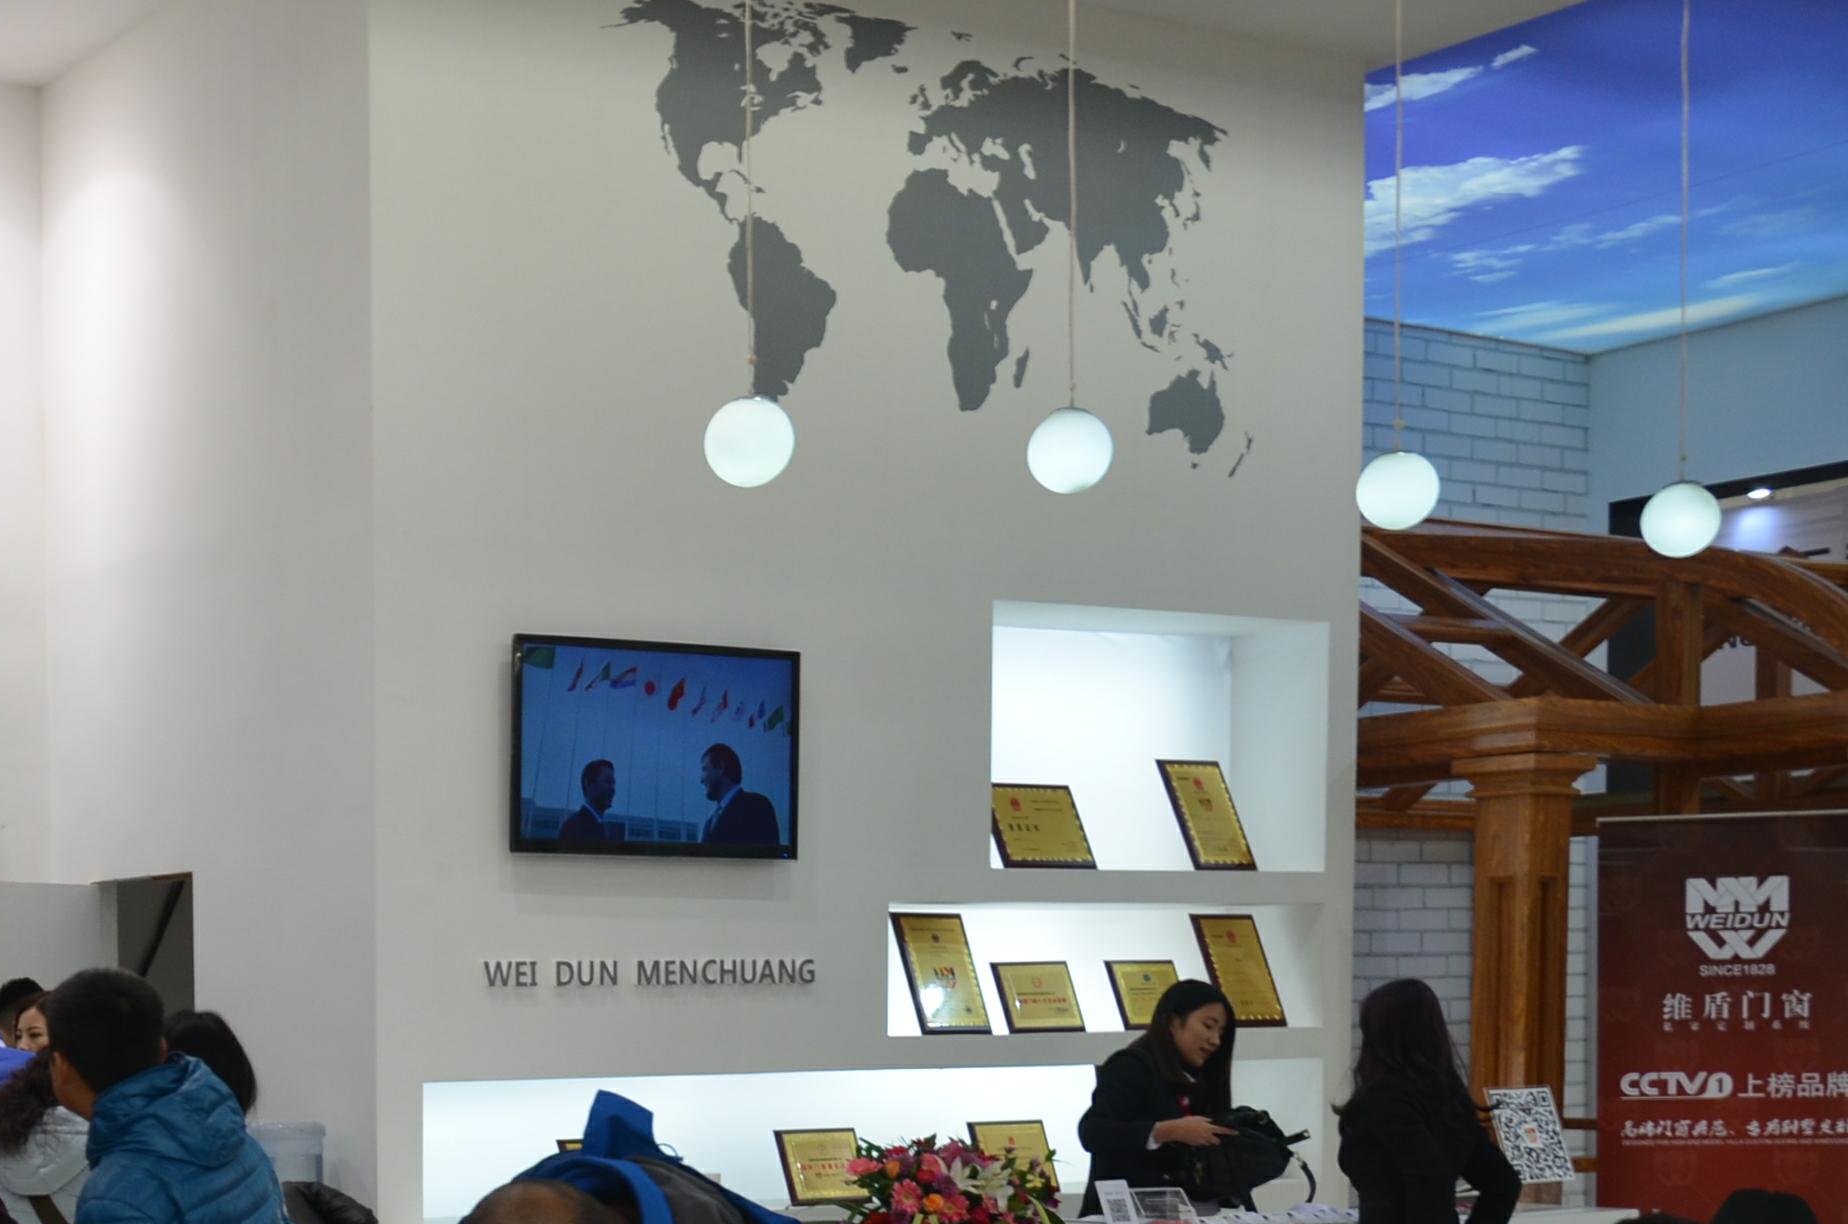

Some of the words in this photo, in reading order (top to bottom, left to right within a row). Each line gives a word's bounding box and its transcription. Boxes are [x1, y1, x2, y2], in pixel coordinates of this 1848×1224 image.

[1686, 912, 1790, 930] WEIDUN
[483, 960, 538, 987] WEI
[556, 960, 619, 987] DUN
[637, 958, 816, 986] MENCHUANG
[1662, 989, 1813, 1021] 维盾门窗
